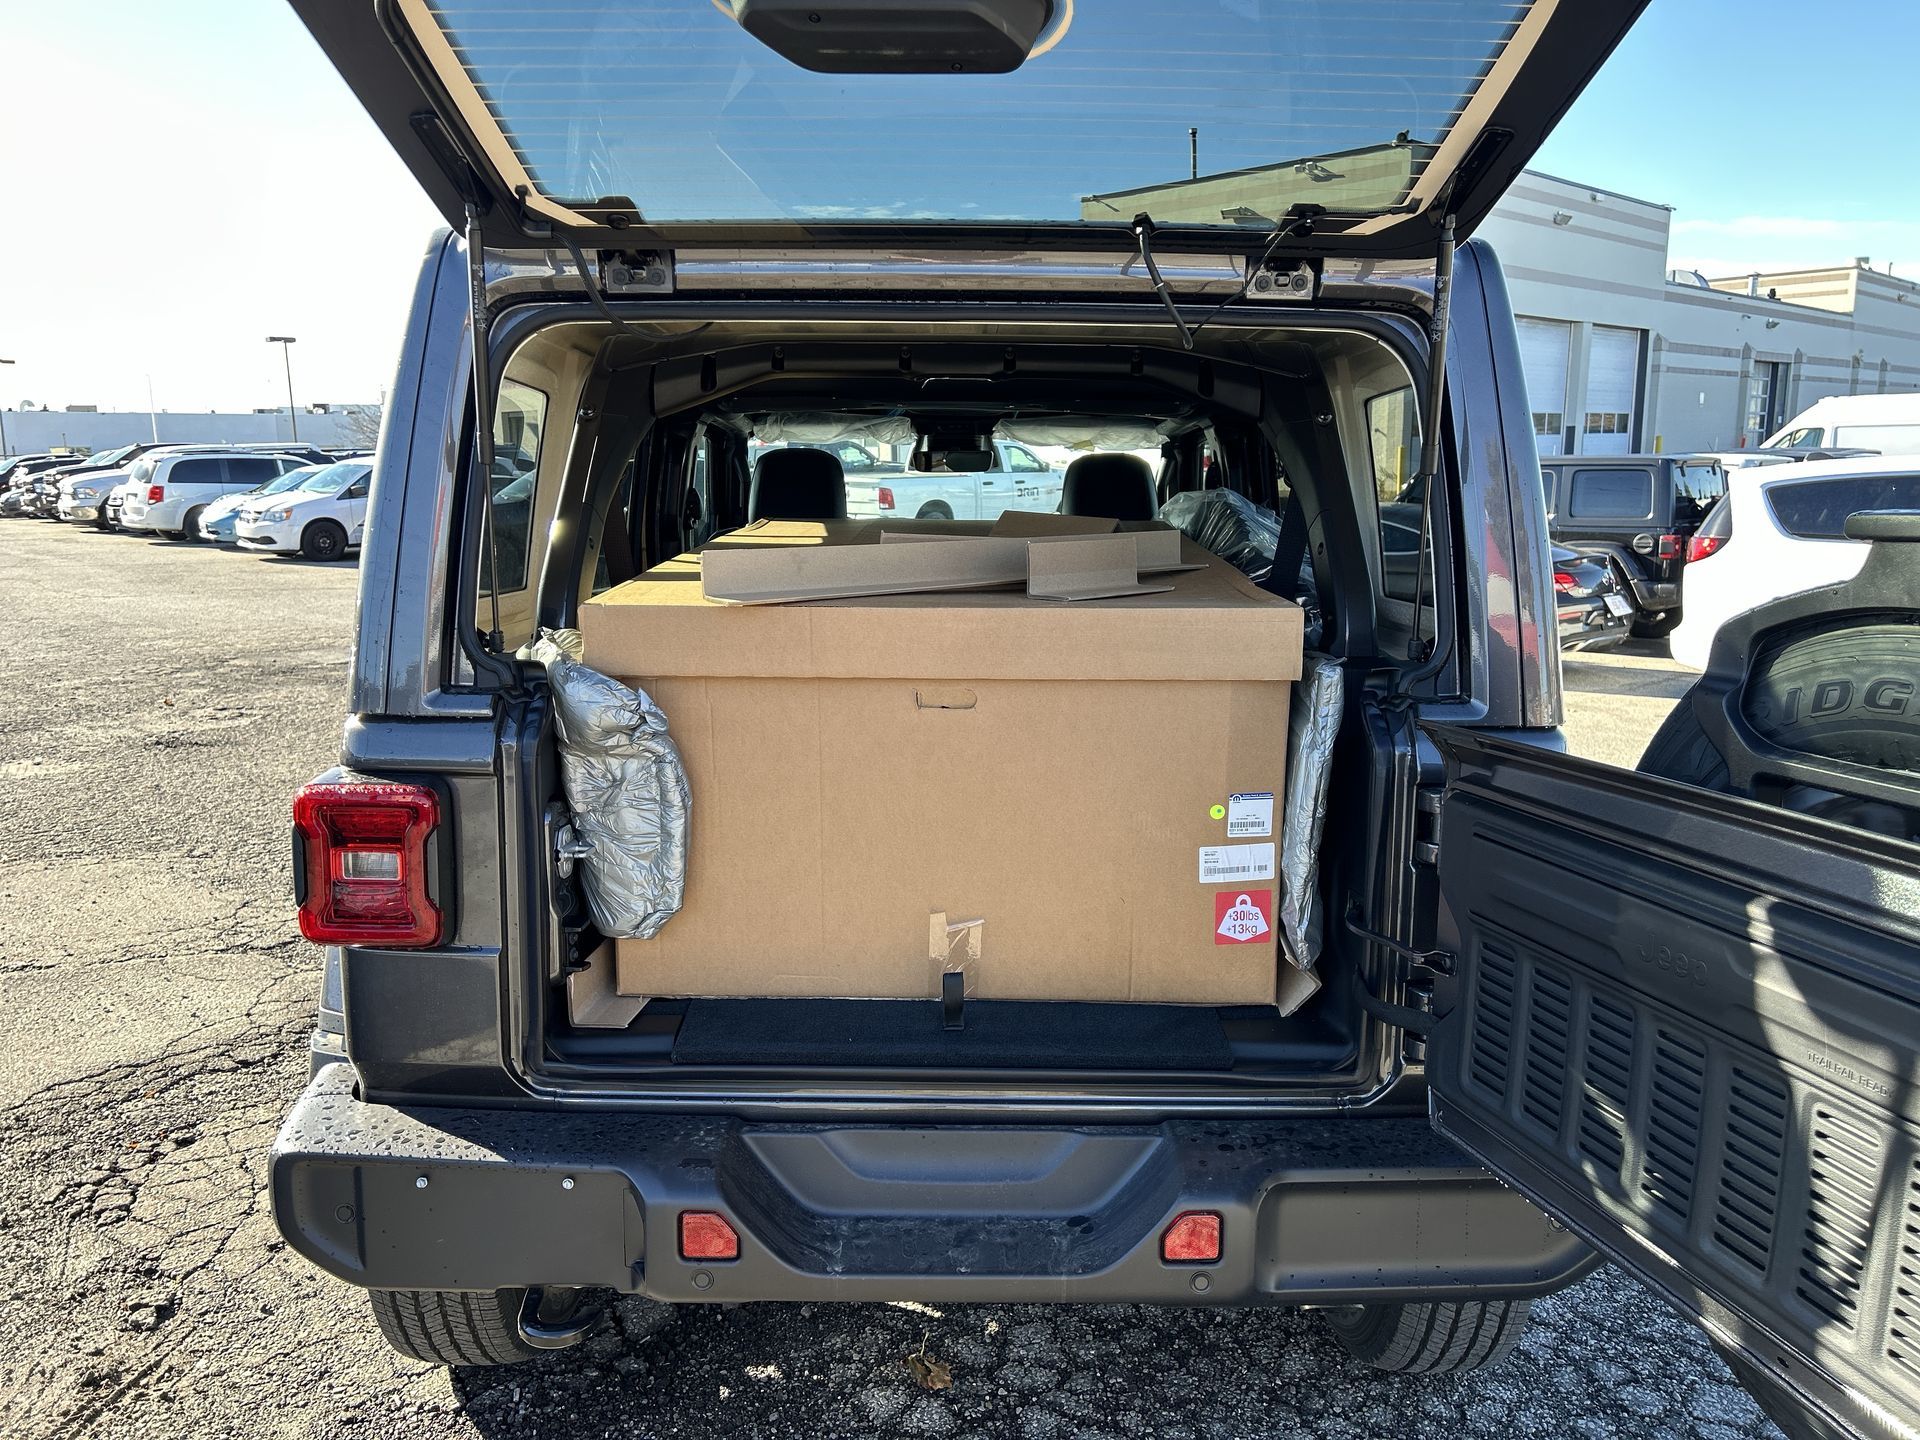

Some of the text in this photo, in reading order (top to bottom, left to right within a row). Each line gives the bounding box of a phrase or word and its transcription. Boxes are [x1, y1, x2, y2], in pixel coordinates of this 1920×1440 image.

[1228, 910, 1260, 921] +30lbs
[1227, 923, 1258, 936] +13kg
[1636, 932, 1708, 987] Jeep
